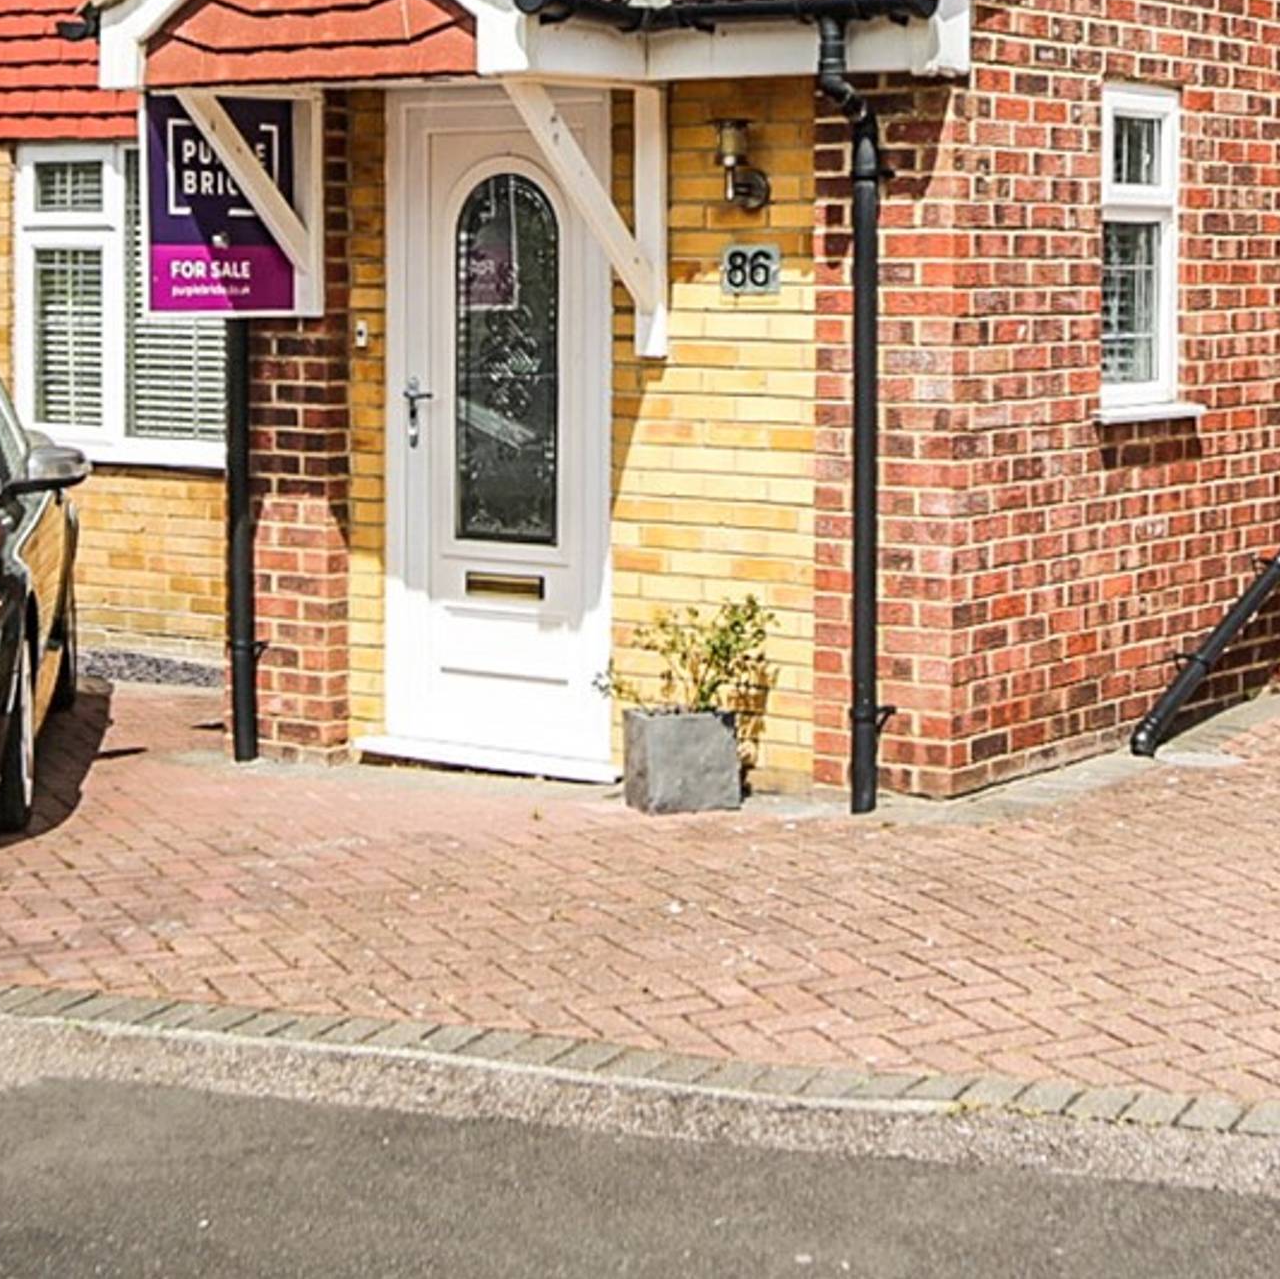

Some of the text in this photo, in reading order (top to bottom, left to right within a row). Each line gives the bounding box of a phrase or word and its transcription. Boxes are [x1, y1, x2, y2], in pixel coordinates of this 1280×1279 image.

[171, 260, 250, 279] FOR SALE
[728, 250, 772, 287] 86
